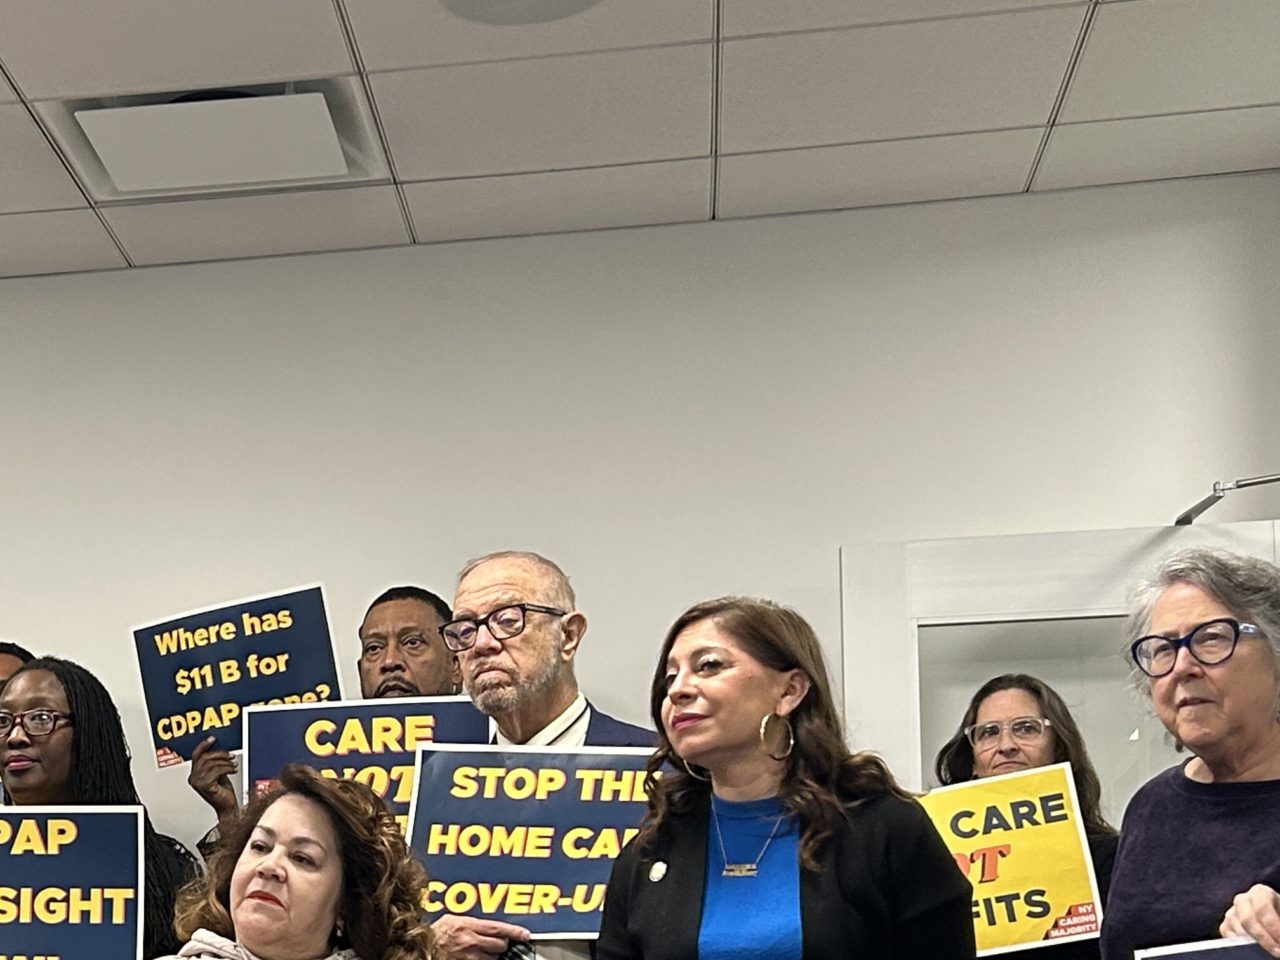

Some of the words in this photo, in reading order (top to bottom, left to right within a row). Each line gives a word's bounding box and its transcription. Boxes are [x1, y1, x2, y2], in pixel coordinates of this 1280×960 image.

[154, 621, 236, 656] Where
[242, 609, 293, 636] has
[175, 664, 214, 695] $11
[220, 659, 241, 683] B
[246, 653, 289, 678] for
[157, 703, 240, 740] CDPAP
[305, 715, 434, 757] CARE
[450, 767, 565, 801] STOP
[949, 793, 1069, 839] CARE
[428, 824, 554, 858] HOME
[421, 881, 607, 914] COVER-U
[1078, 904, 1093, 914] NY
[1050, 923, 1098, 937] MAJORITY
